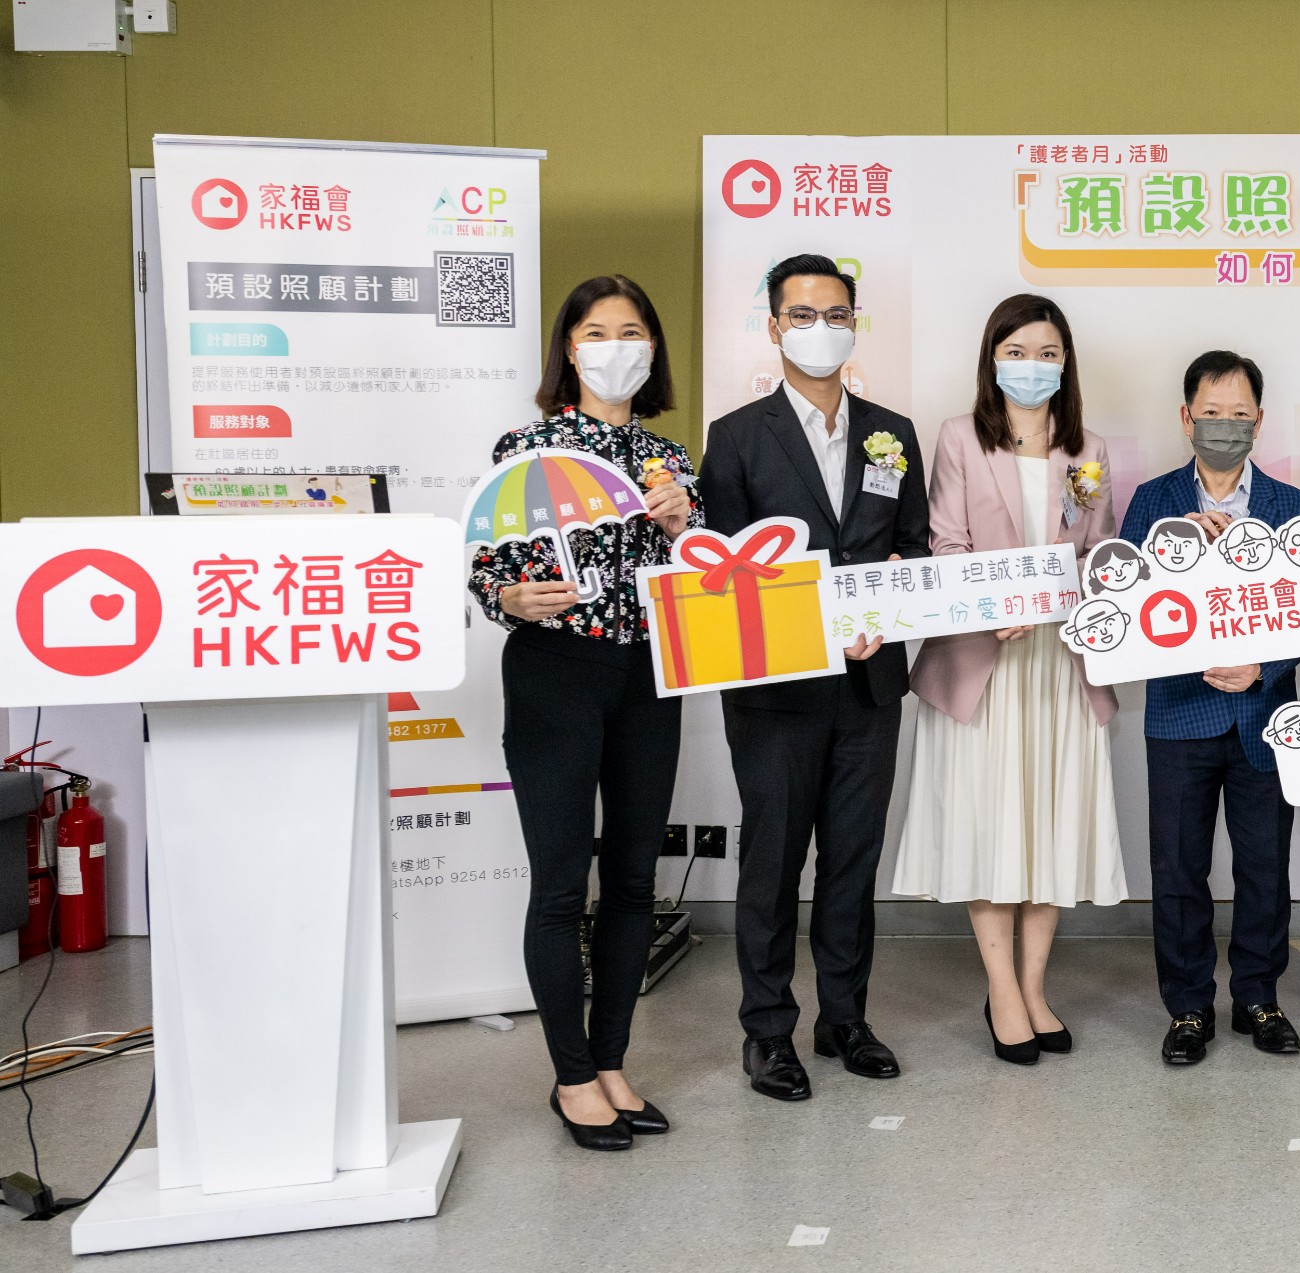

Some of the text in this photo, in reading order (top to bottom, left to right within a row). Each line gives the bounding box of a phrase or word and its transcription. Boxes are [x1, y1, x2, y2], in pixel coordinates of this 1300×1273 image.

[1016, 144, 1168, 164] 「護老者月」活動
[793, 162, 893, 194] 家福會
[259, 183, 352, 212] 家福會
[432, 185, 508, 215] ACP
[793, 197, 893, 217] HKFWS
[259, 213, 352, 231] HKFWS
[427, 223, 514, 237] 預設照顧計劃
[205, 273, 420, 302] 預設照顧計劃
[207, 333, 268, 347] 計劃目的
[209, 415, 270, 429] 服務對象
[195, 448, 279, 461] 在社區居住的
[193, 548, 424, 618] 家福會
[833, 552, 1067, 599] 預早規劃 坦誠溝通
[1205, 577, 1299, 617] 家福會
[832, 589, 1079, 639] 給家人一份愛的禮物
[193, 621, 422, 668] HKFWS
[415, 723, 447, 735] 1377
[391, 811, 471, 831] 照顧計劃
[450, 870, 487, 883] 9254
[493, 867, 529, 880] 8512
